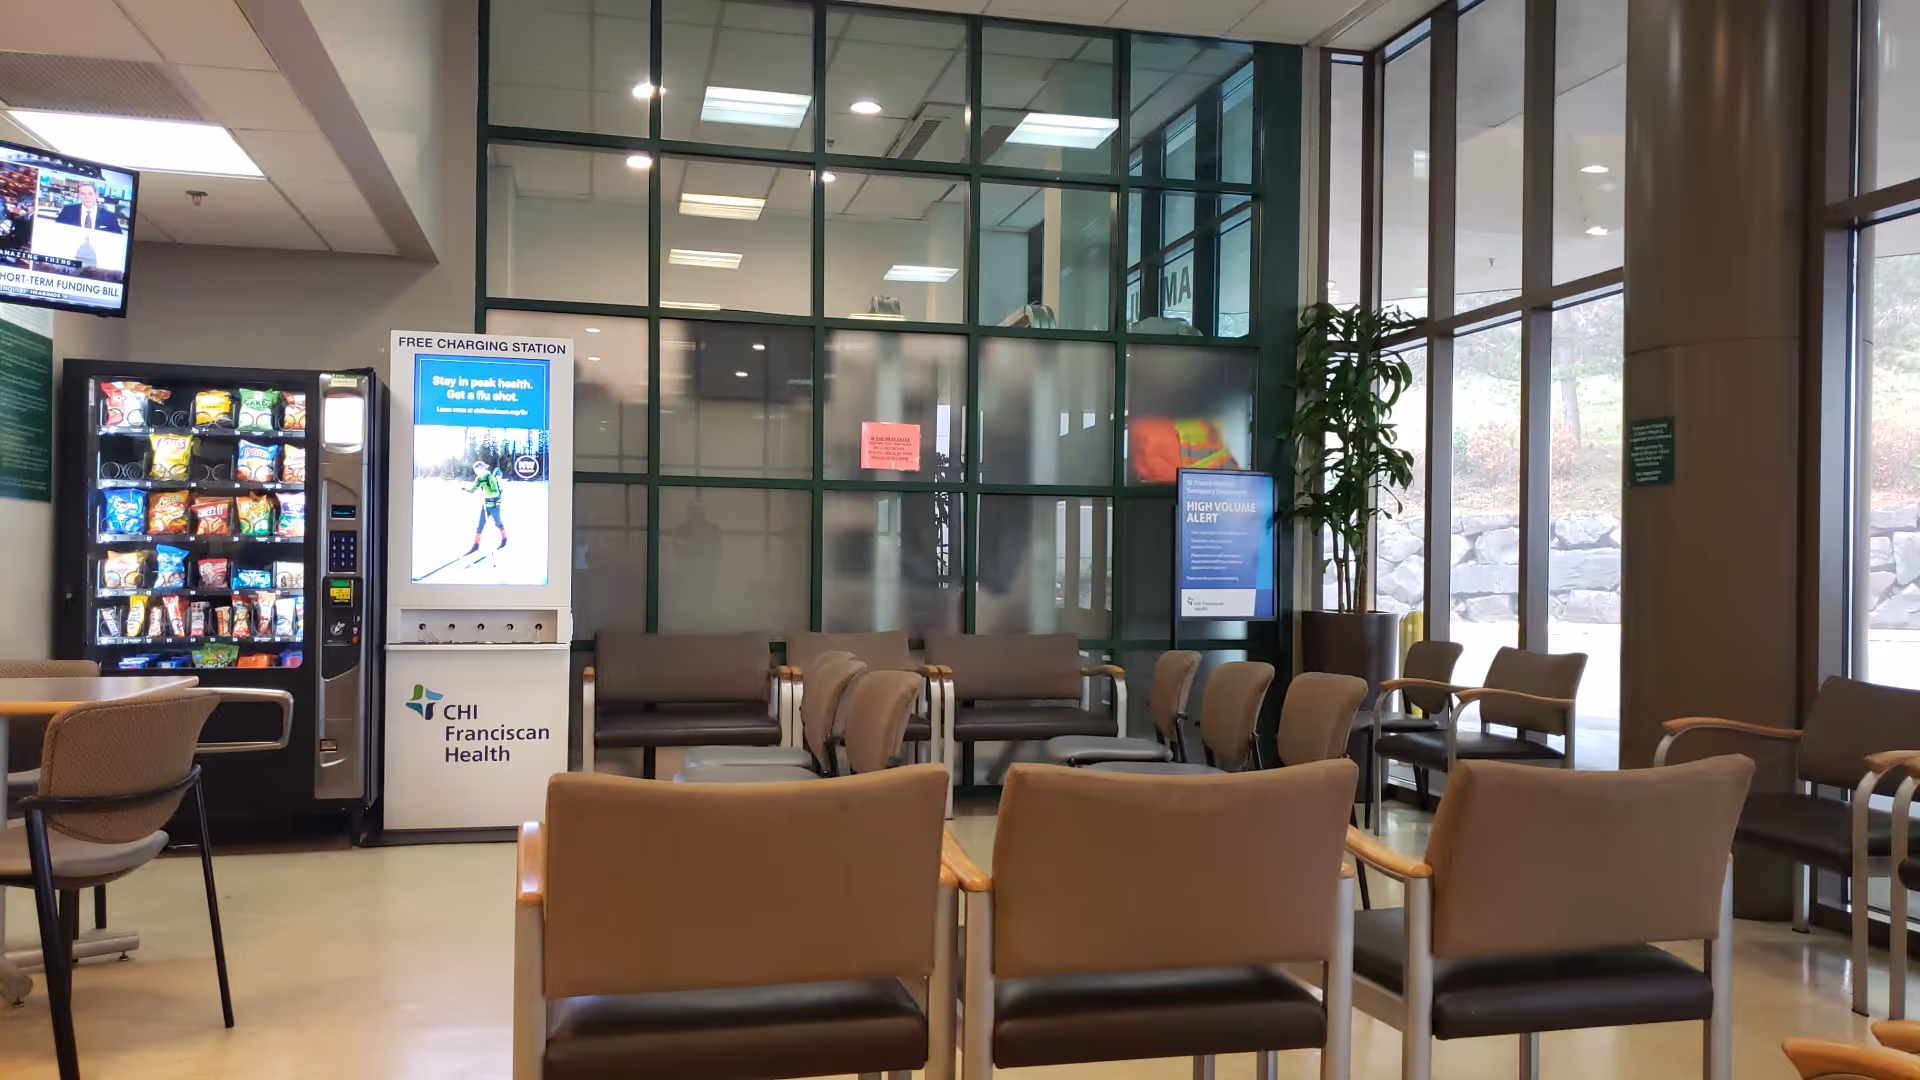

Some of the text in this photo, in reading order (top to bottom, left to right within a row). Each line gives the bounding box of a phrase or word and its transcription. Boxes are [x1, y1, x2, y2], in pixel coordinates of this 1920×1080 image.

[57, 280, 100, 294] FUNDING
[102, 286, 119, 297] BILL
[399, 337, 566, 354] FREE CHARGING STATION
[432, 375, 533, 390] Stay in peak health.
[447, 389, 519, 402] Get a flu shot.
[1186, 501, 1256, 513] HIGH VOLUME
[1186, 513, 1218, 523] ALERT
[444, 704, 478, 720] CHI
[445, 724, 550, 741] Franciscan
[445, 745, 510, 763] Health
